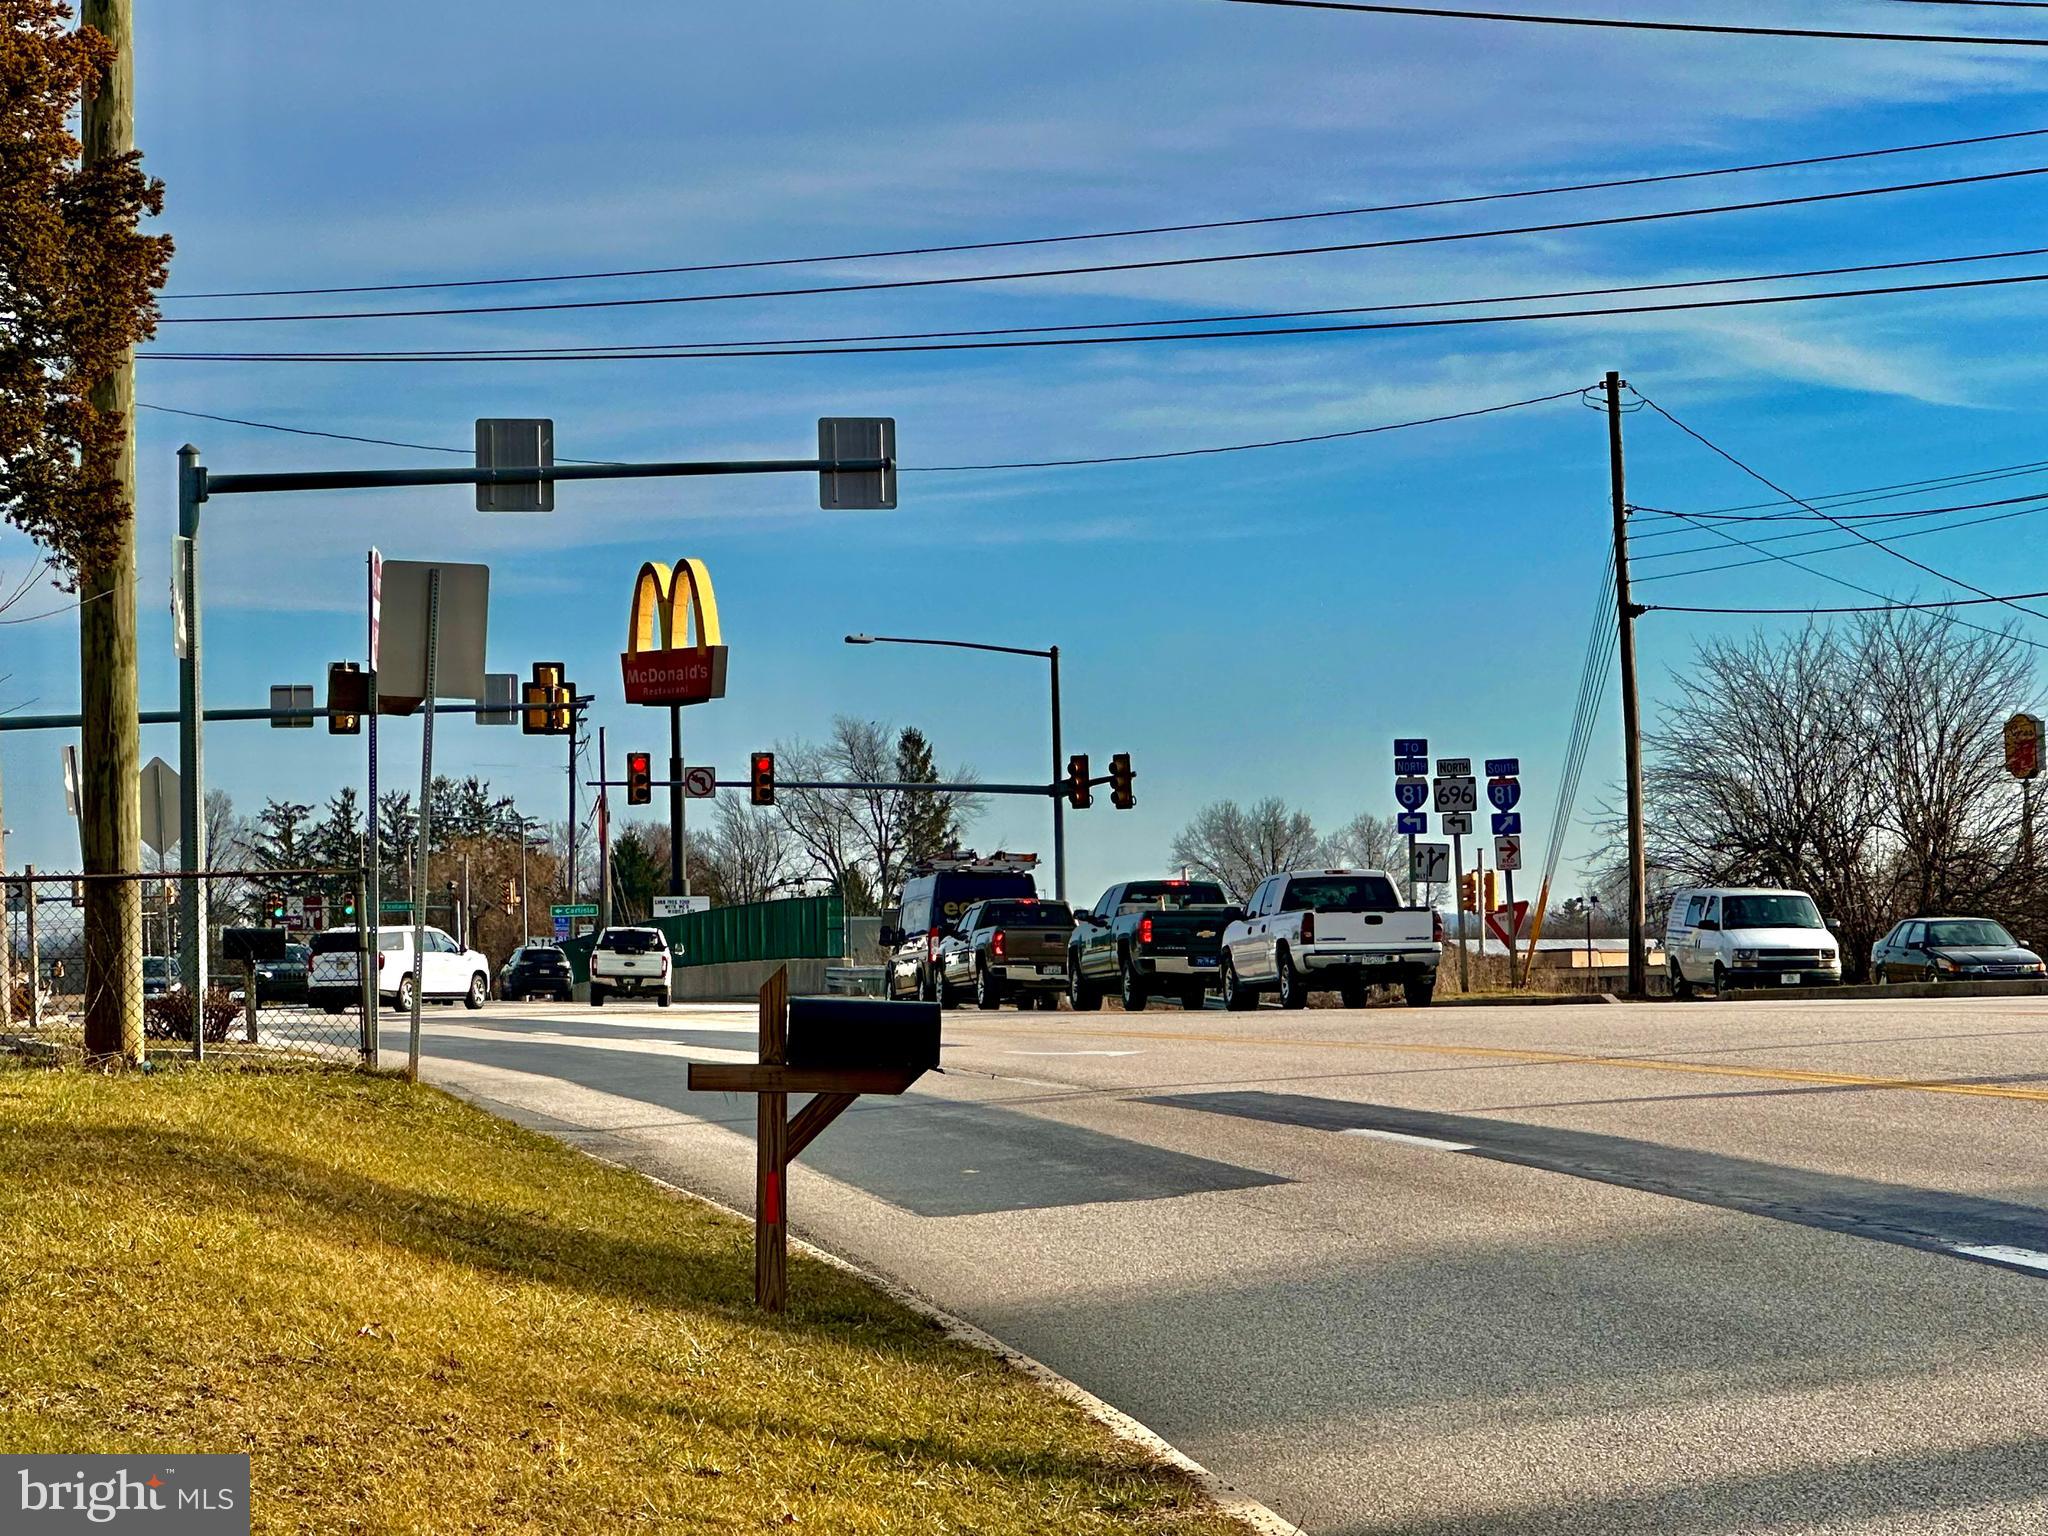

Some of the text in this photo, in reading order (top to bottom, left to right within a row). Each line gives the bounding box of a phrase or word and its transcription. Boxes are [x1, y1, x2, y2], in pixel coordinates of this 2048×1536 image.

[626, 664, 708, 684] McDonald's
[643, 686, 689, 696] Restaurant
[1403, 743, 1419, 753] TO
[1397, 762, 1426, 772] NORTH
[1439, 762, 1469, 773] NORTH
[1487, 762, 1518, 774] SOUTH
[1402, 785, 1423, 804] 81
[1438, 785, 1473, 805] 696
[1494, 785, 1513, 805] 81
